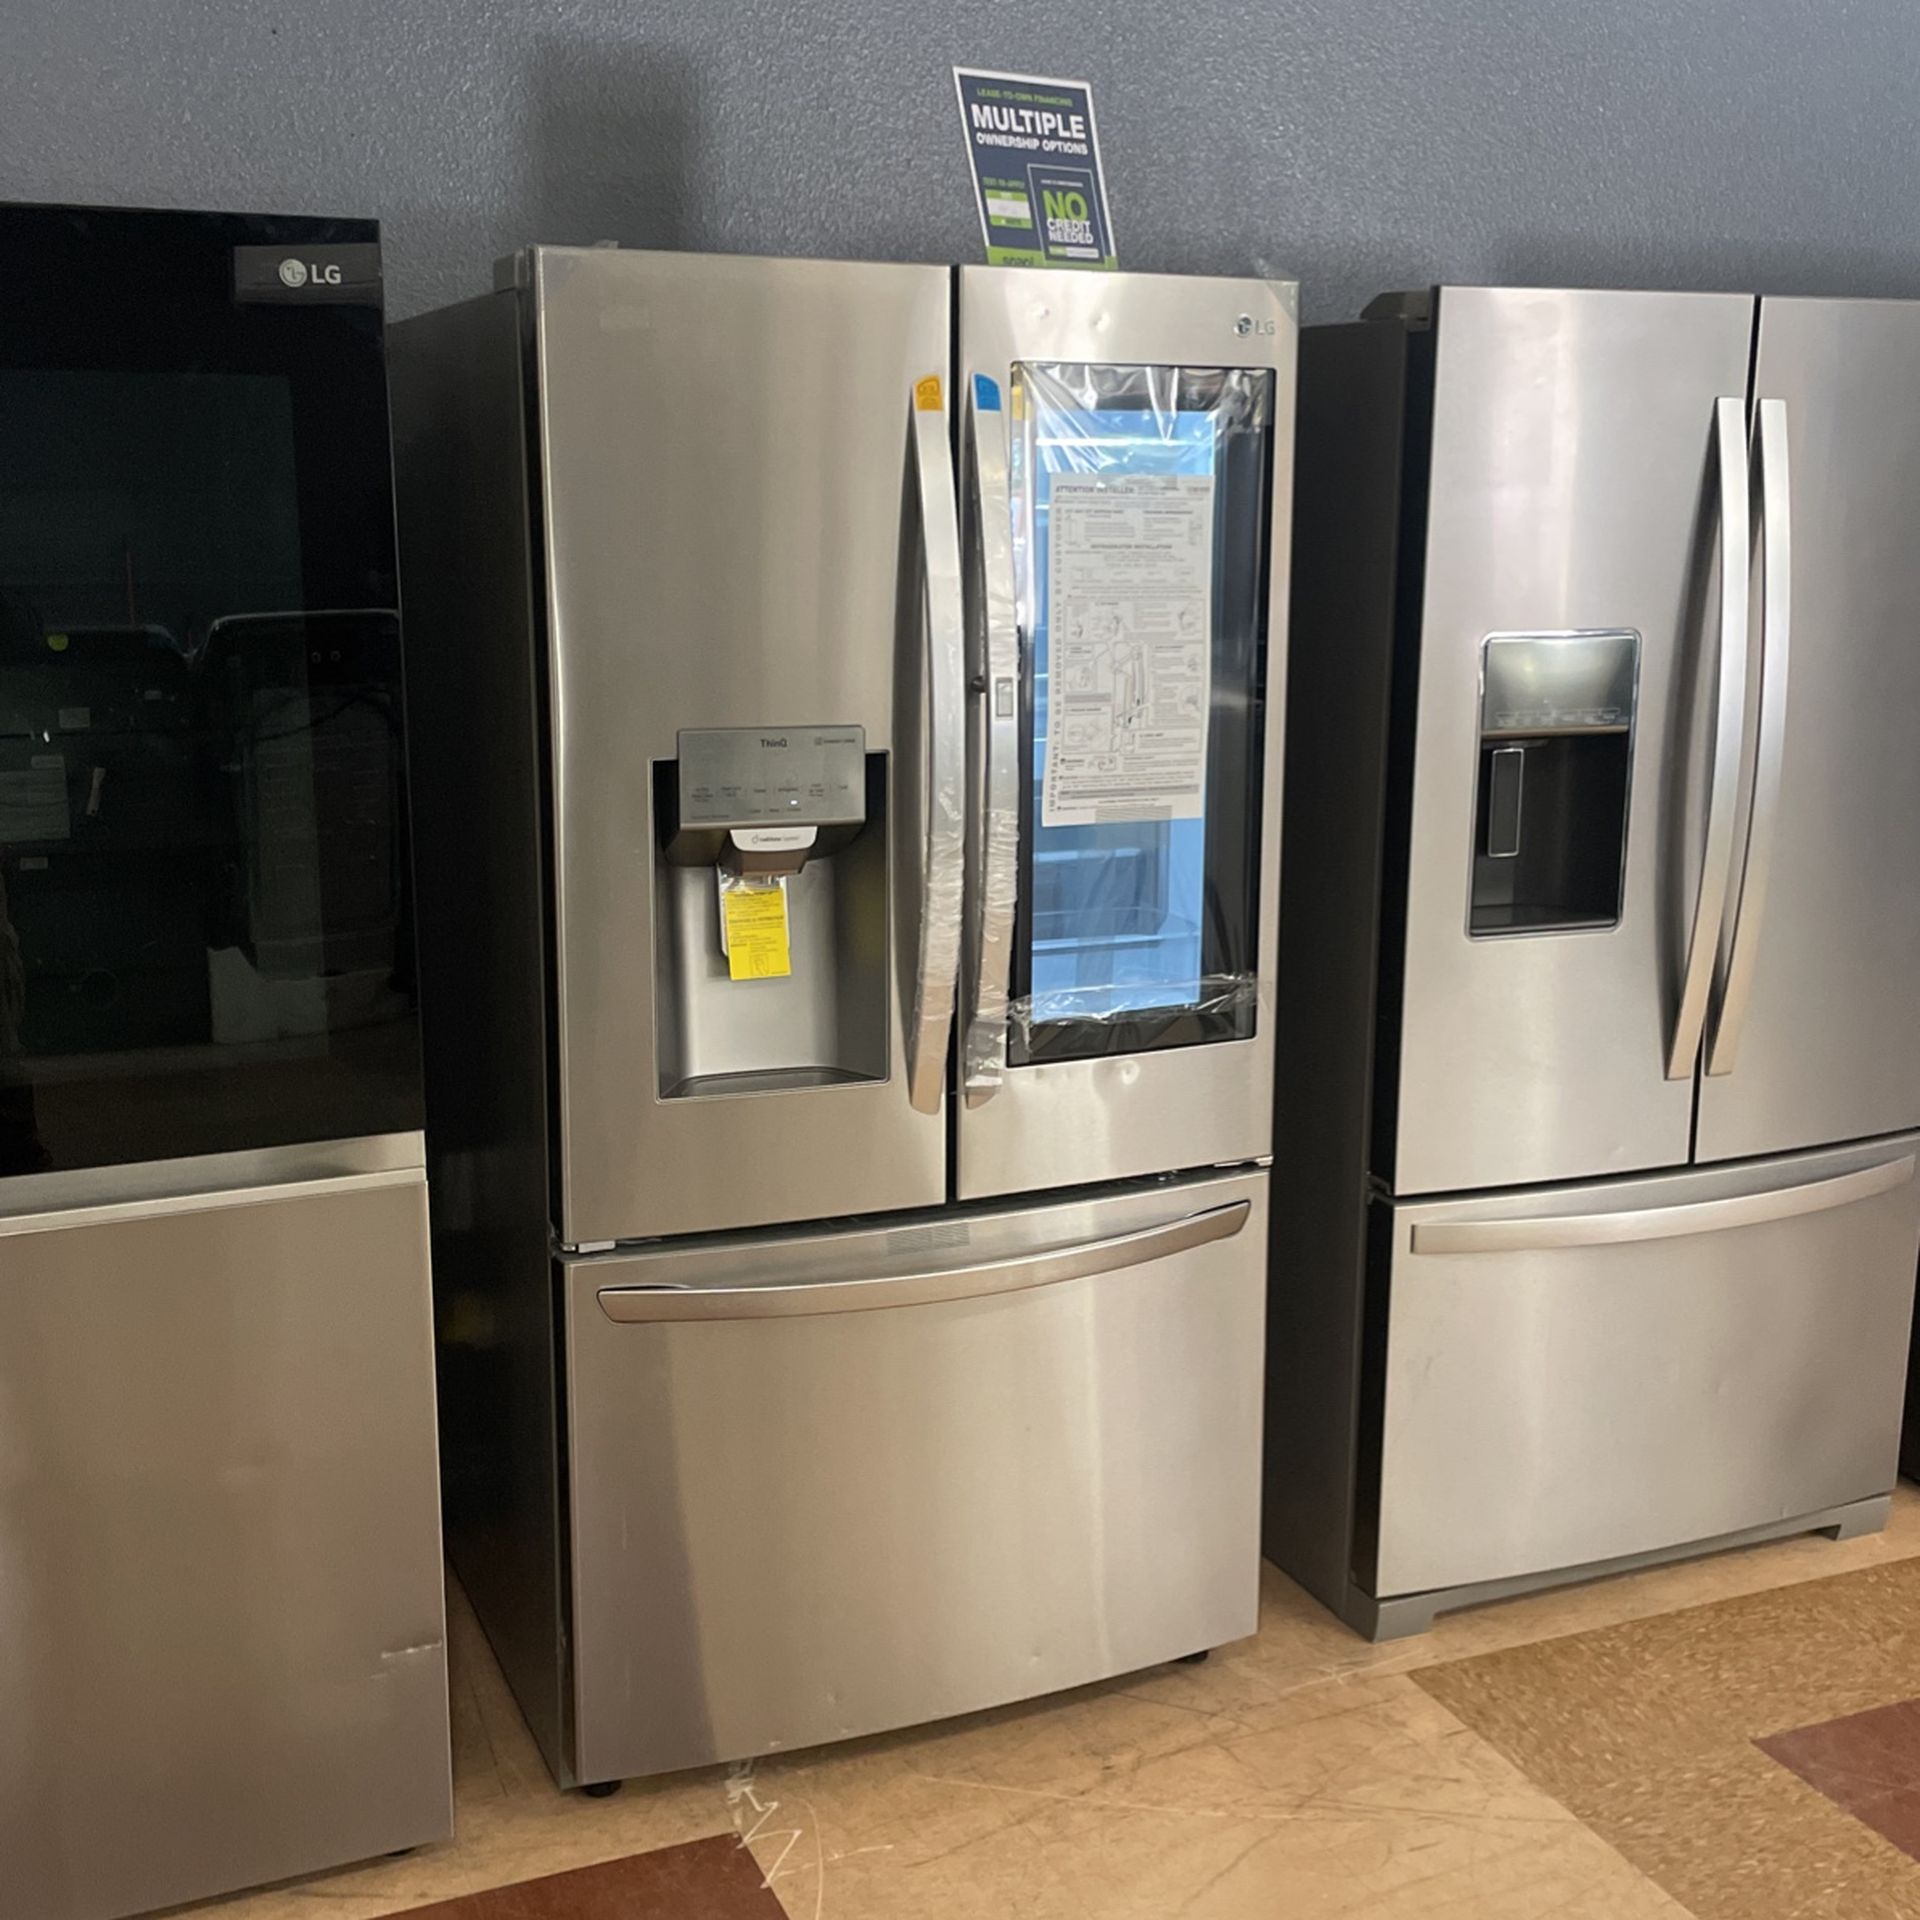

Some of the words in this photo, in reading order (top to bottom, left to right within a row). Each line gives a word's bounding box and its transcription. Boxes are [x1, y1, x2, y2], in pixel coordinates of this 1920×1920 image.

[971, 103, 1086, 139] MULTIPLE
[976, 132, 1040, 150] OWNERSHIP
[1042, 140, 1088, 155] OPTIONS
[1043, 190, 1088, 221] NO
[1046, 217, 1090, 233] CREDIT
[1048, 230, 1093, 245] NEEDED
[311, 263, 342, 284] LG
[1255, 319, 1276, 336] LG
[760, 738, 788, 748] ThinQ
